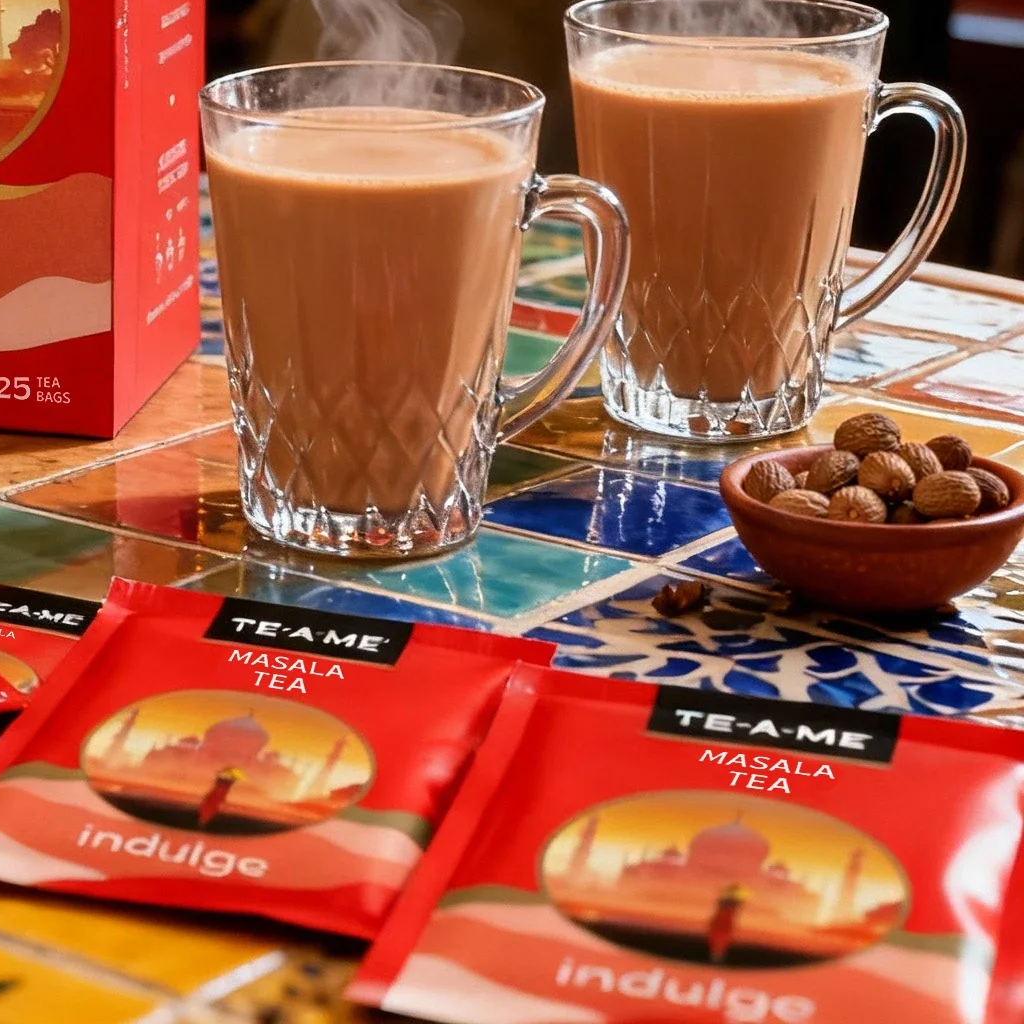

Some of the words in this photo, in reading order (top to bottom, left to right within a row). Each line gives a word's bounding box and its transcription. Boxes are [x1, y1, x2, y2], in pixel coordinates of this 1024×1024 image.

[36, 376, 61, 389] TEA
[36, 390, 72, 404] BAGS
[231, 617, 385, 653] TE-A-ME
[228, 649, 345, 680] MASALA
[253, 670, 307, 694] TEA
[675, 709, 874, 750] TE-A-ME
[698, 749, 836, 780] MASALA
[728, 771, 791, 794] TEA
[76, 823, 268, 878] indulge
